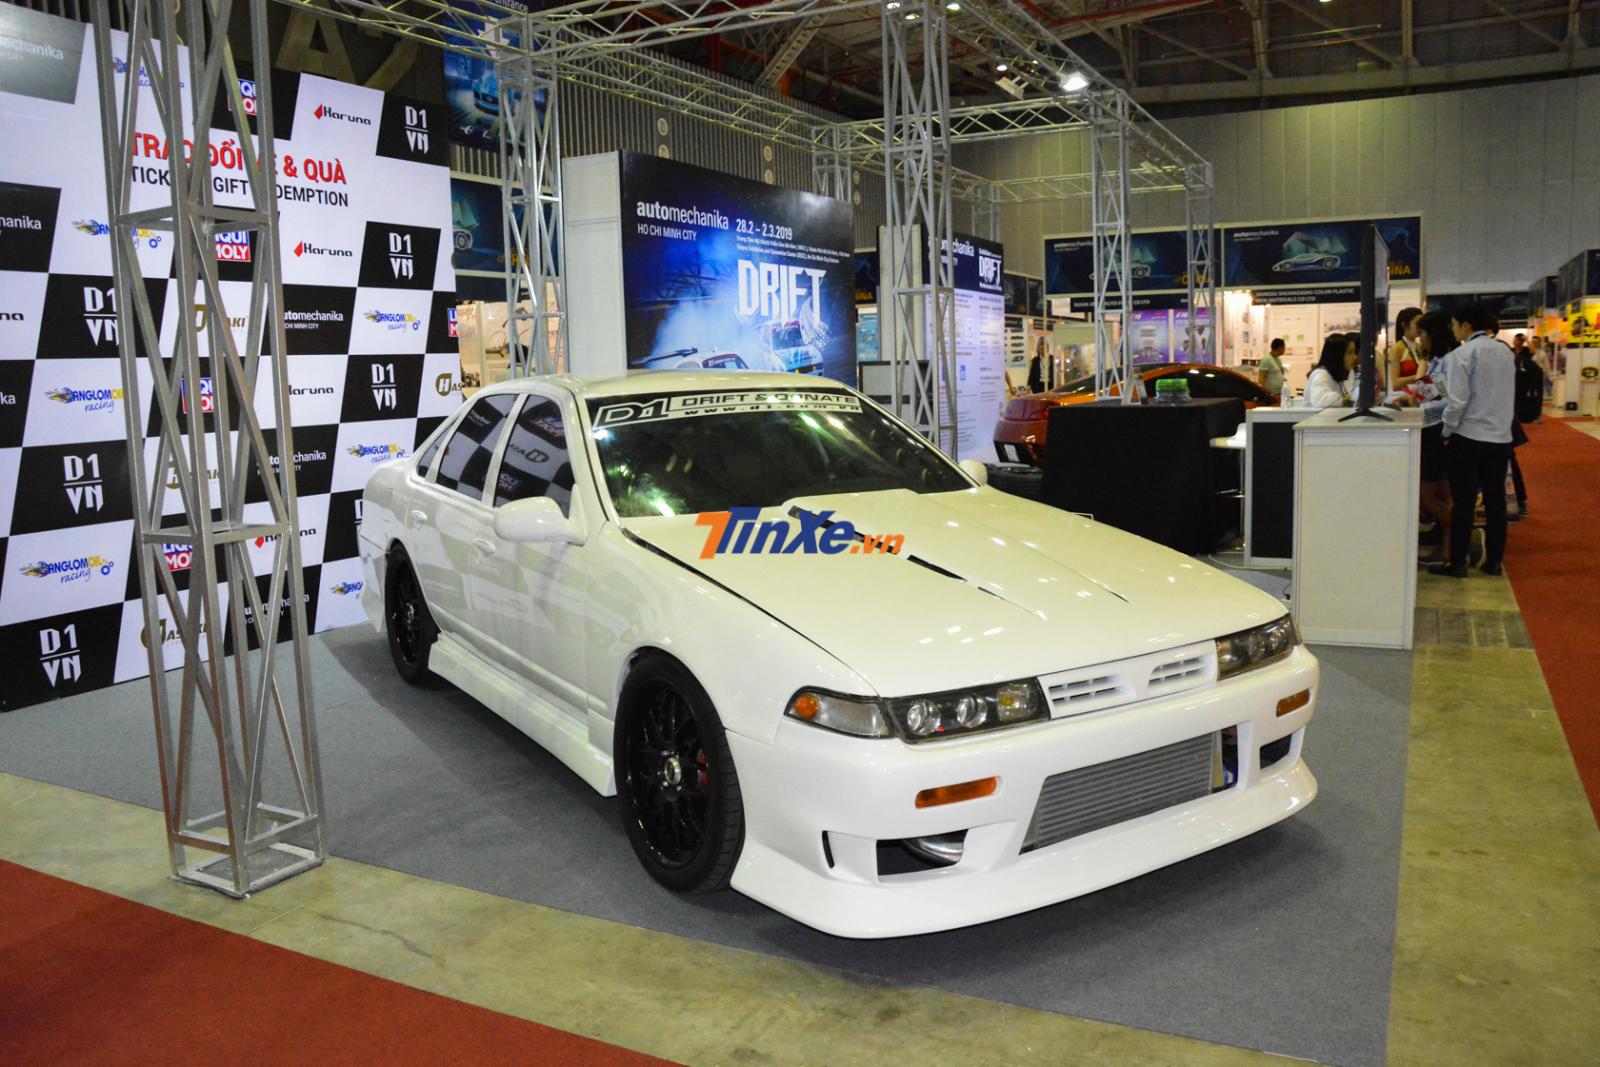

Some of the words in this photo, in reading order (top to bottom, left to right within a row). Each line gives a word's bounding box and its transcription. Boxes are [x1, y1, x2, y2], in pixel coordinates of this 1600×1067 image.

[323, 106, 372, 126] Haruna
[405, 105, 427, 128] D1
[406, 130, 429, 154] VN
[283, 155, 298, 177] &
[303, 158, 347, 185] QUÀ
[213, 176, 249, 195] GIFT
[276, 185, 349, 207] DEMPTION
[636, 200, 729, 230] automechanika
[637, 223, 648, 234] HO
[649, 225, 662, 236] CHI
[663, 227, 682, 240] MINH
[682, 230, 697, 241] CITY
[736, 218, 754, 235] 28.2
[762, 222, 793, 241] 2.3.2019
[303, 242, 353, 257] Haruna
[389, 232, 412, 254] D1
[390, 258, 414, 280] VN
[737, 258, 828, 328] DRIFT
[371, 363, 395, 385] D1
[372, 388, 397, 411] VN
[681, 393, 749, 407] DRIFT
[63, 453, 100, 481] D1
[65, 484, 104, 515] VN
[39, 623, 78, 655] D1
[42, 655, 82, 688] VN
